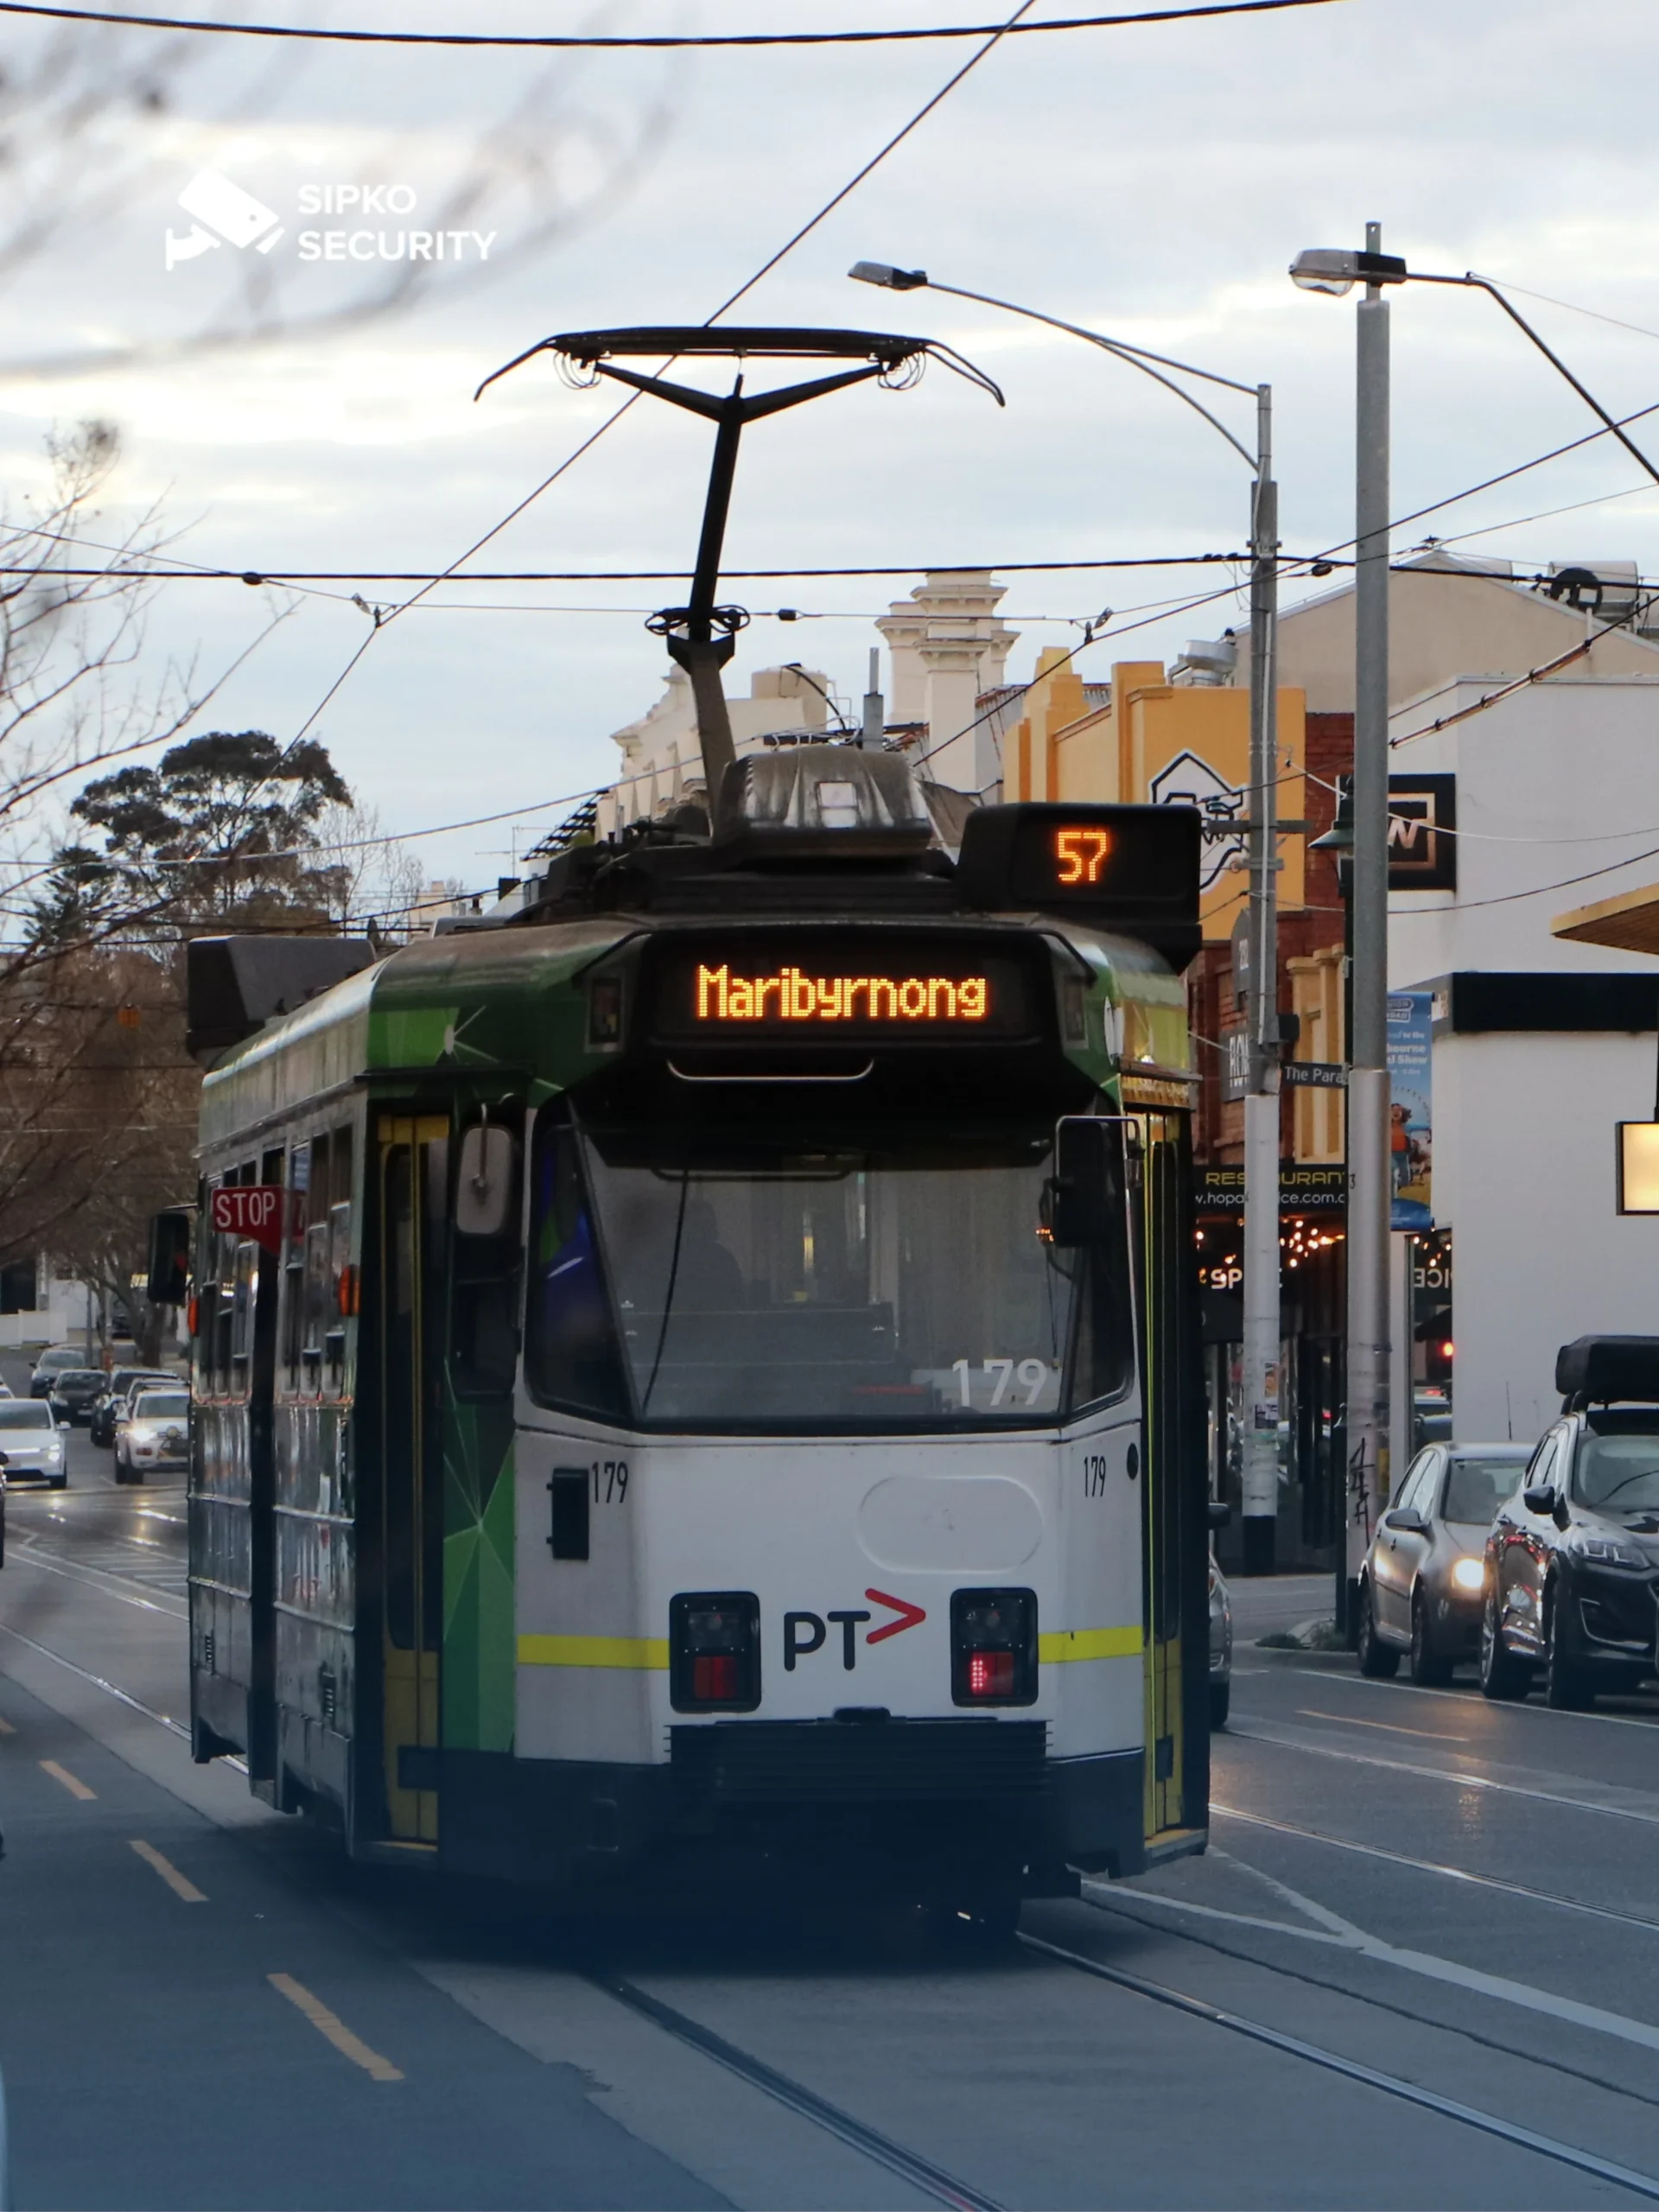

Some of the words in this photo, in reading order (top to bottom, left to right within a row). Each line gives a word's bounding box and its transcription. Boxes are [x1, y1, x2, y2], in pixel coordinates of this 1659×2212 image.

[1058, 831, 1107, 881] 57
[698, 963, 986, 1018] Maribyrnong
[1285, 1065, 1308, 1081] The
[1313, 1068, 1344, 1084] Para
[1205, 1172, 1345, 1185] RESURAN
[216, 1191, 276, 1228] STOP
[952, 1357, 1047, 1407] 179
[592, 1460, 628, 1503] 179
[1084, 1455, 1106, 1497] 179
[784, 1611, 871, 1671] PT
